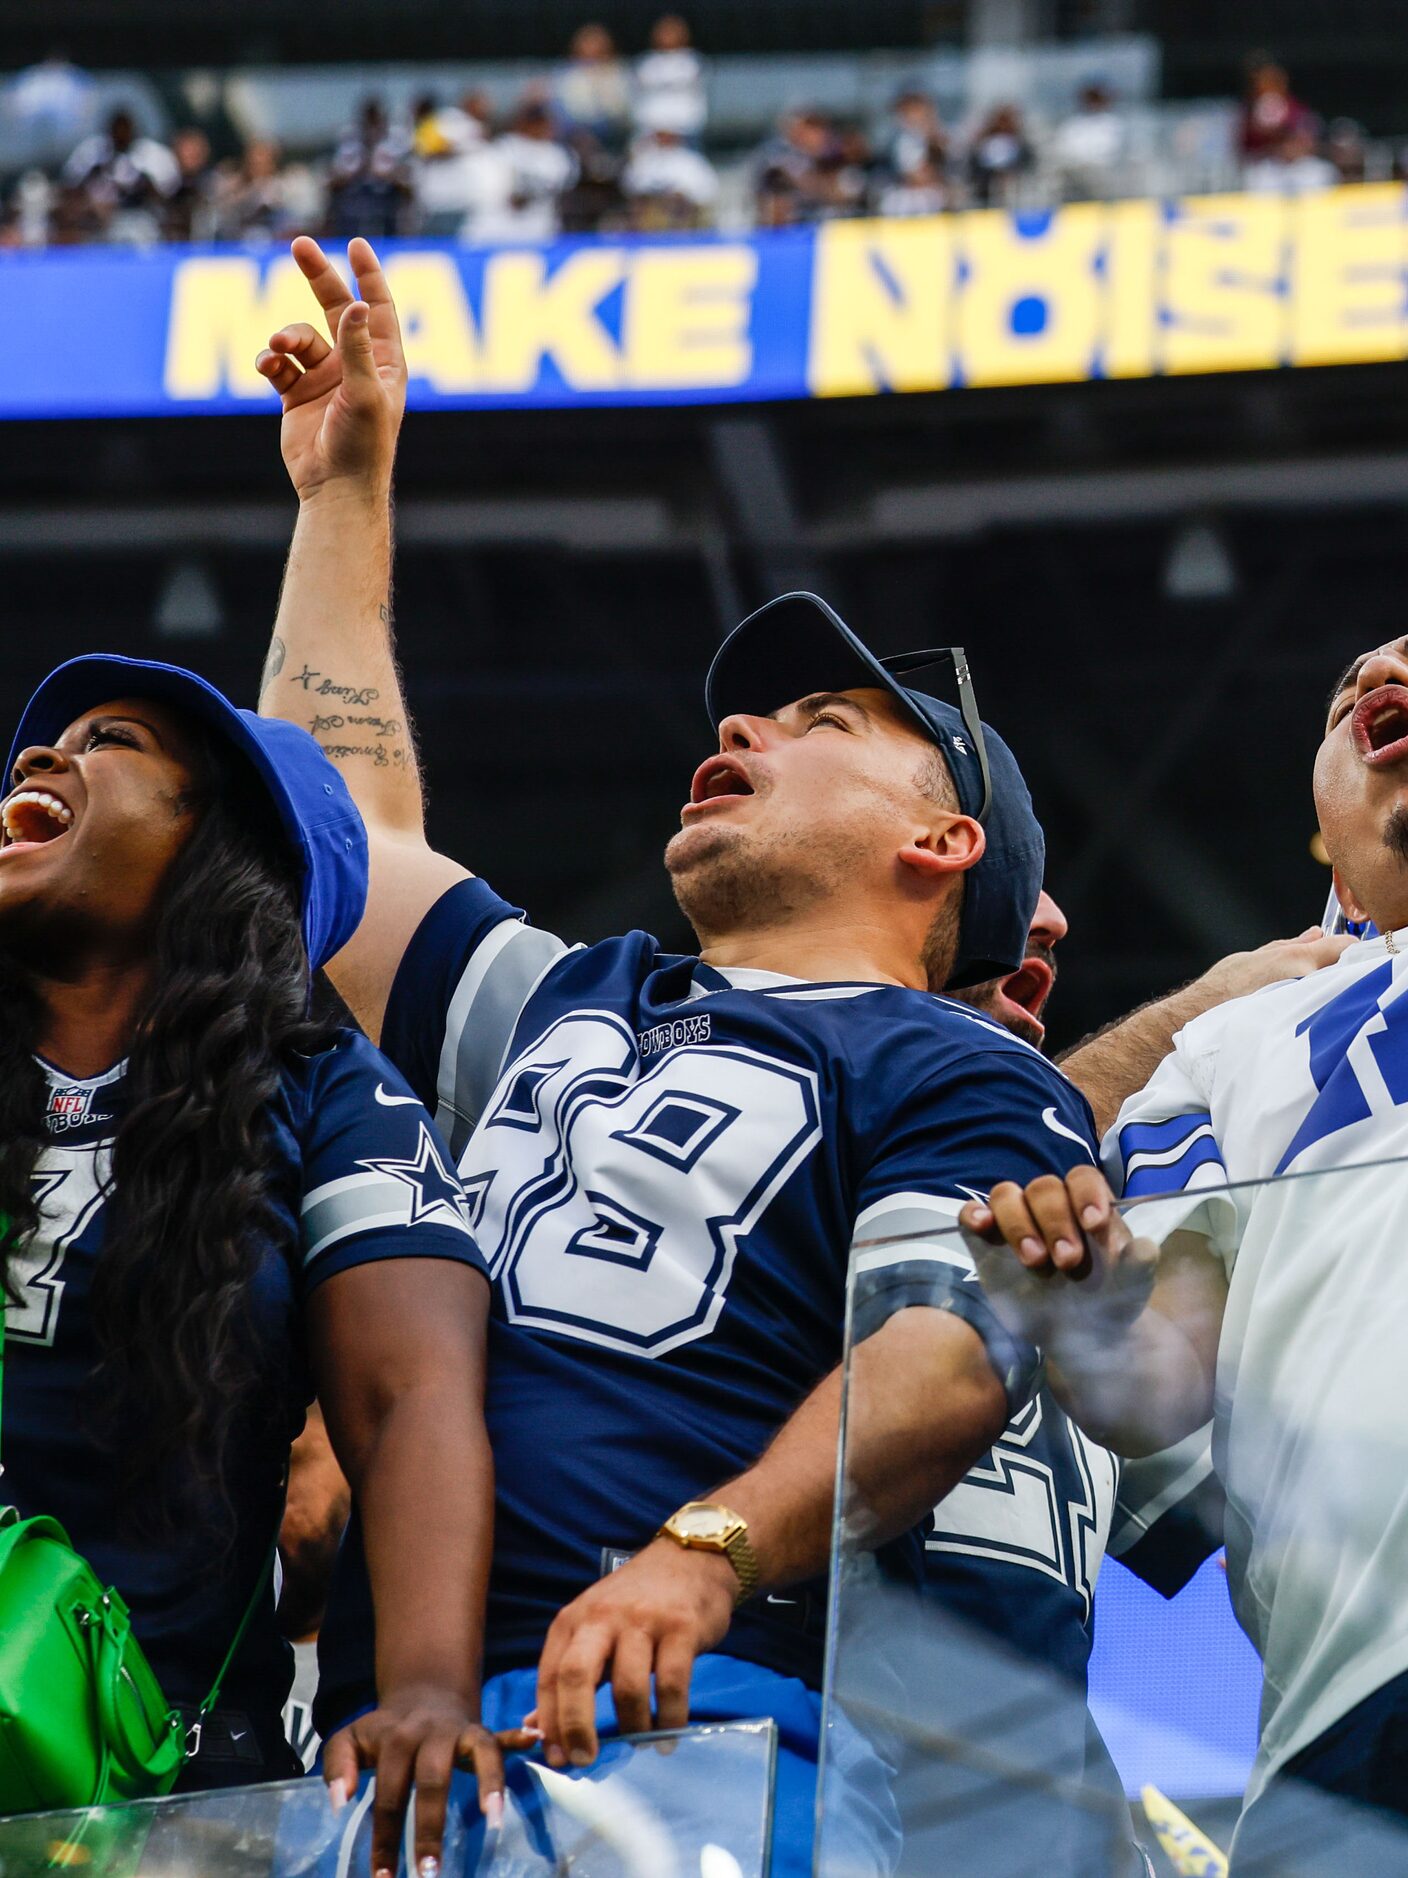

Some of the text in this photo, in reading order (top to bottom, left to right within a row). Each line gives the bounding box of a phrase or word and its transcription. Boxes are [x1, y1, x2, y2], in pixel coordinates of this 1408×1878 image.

[165, 244, 757, 399] MAKE
[315, 678, 380, 706] King
[51, 1096, 84, 1114] NFL
